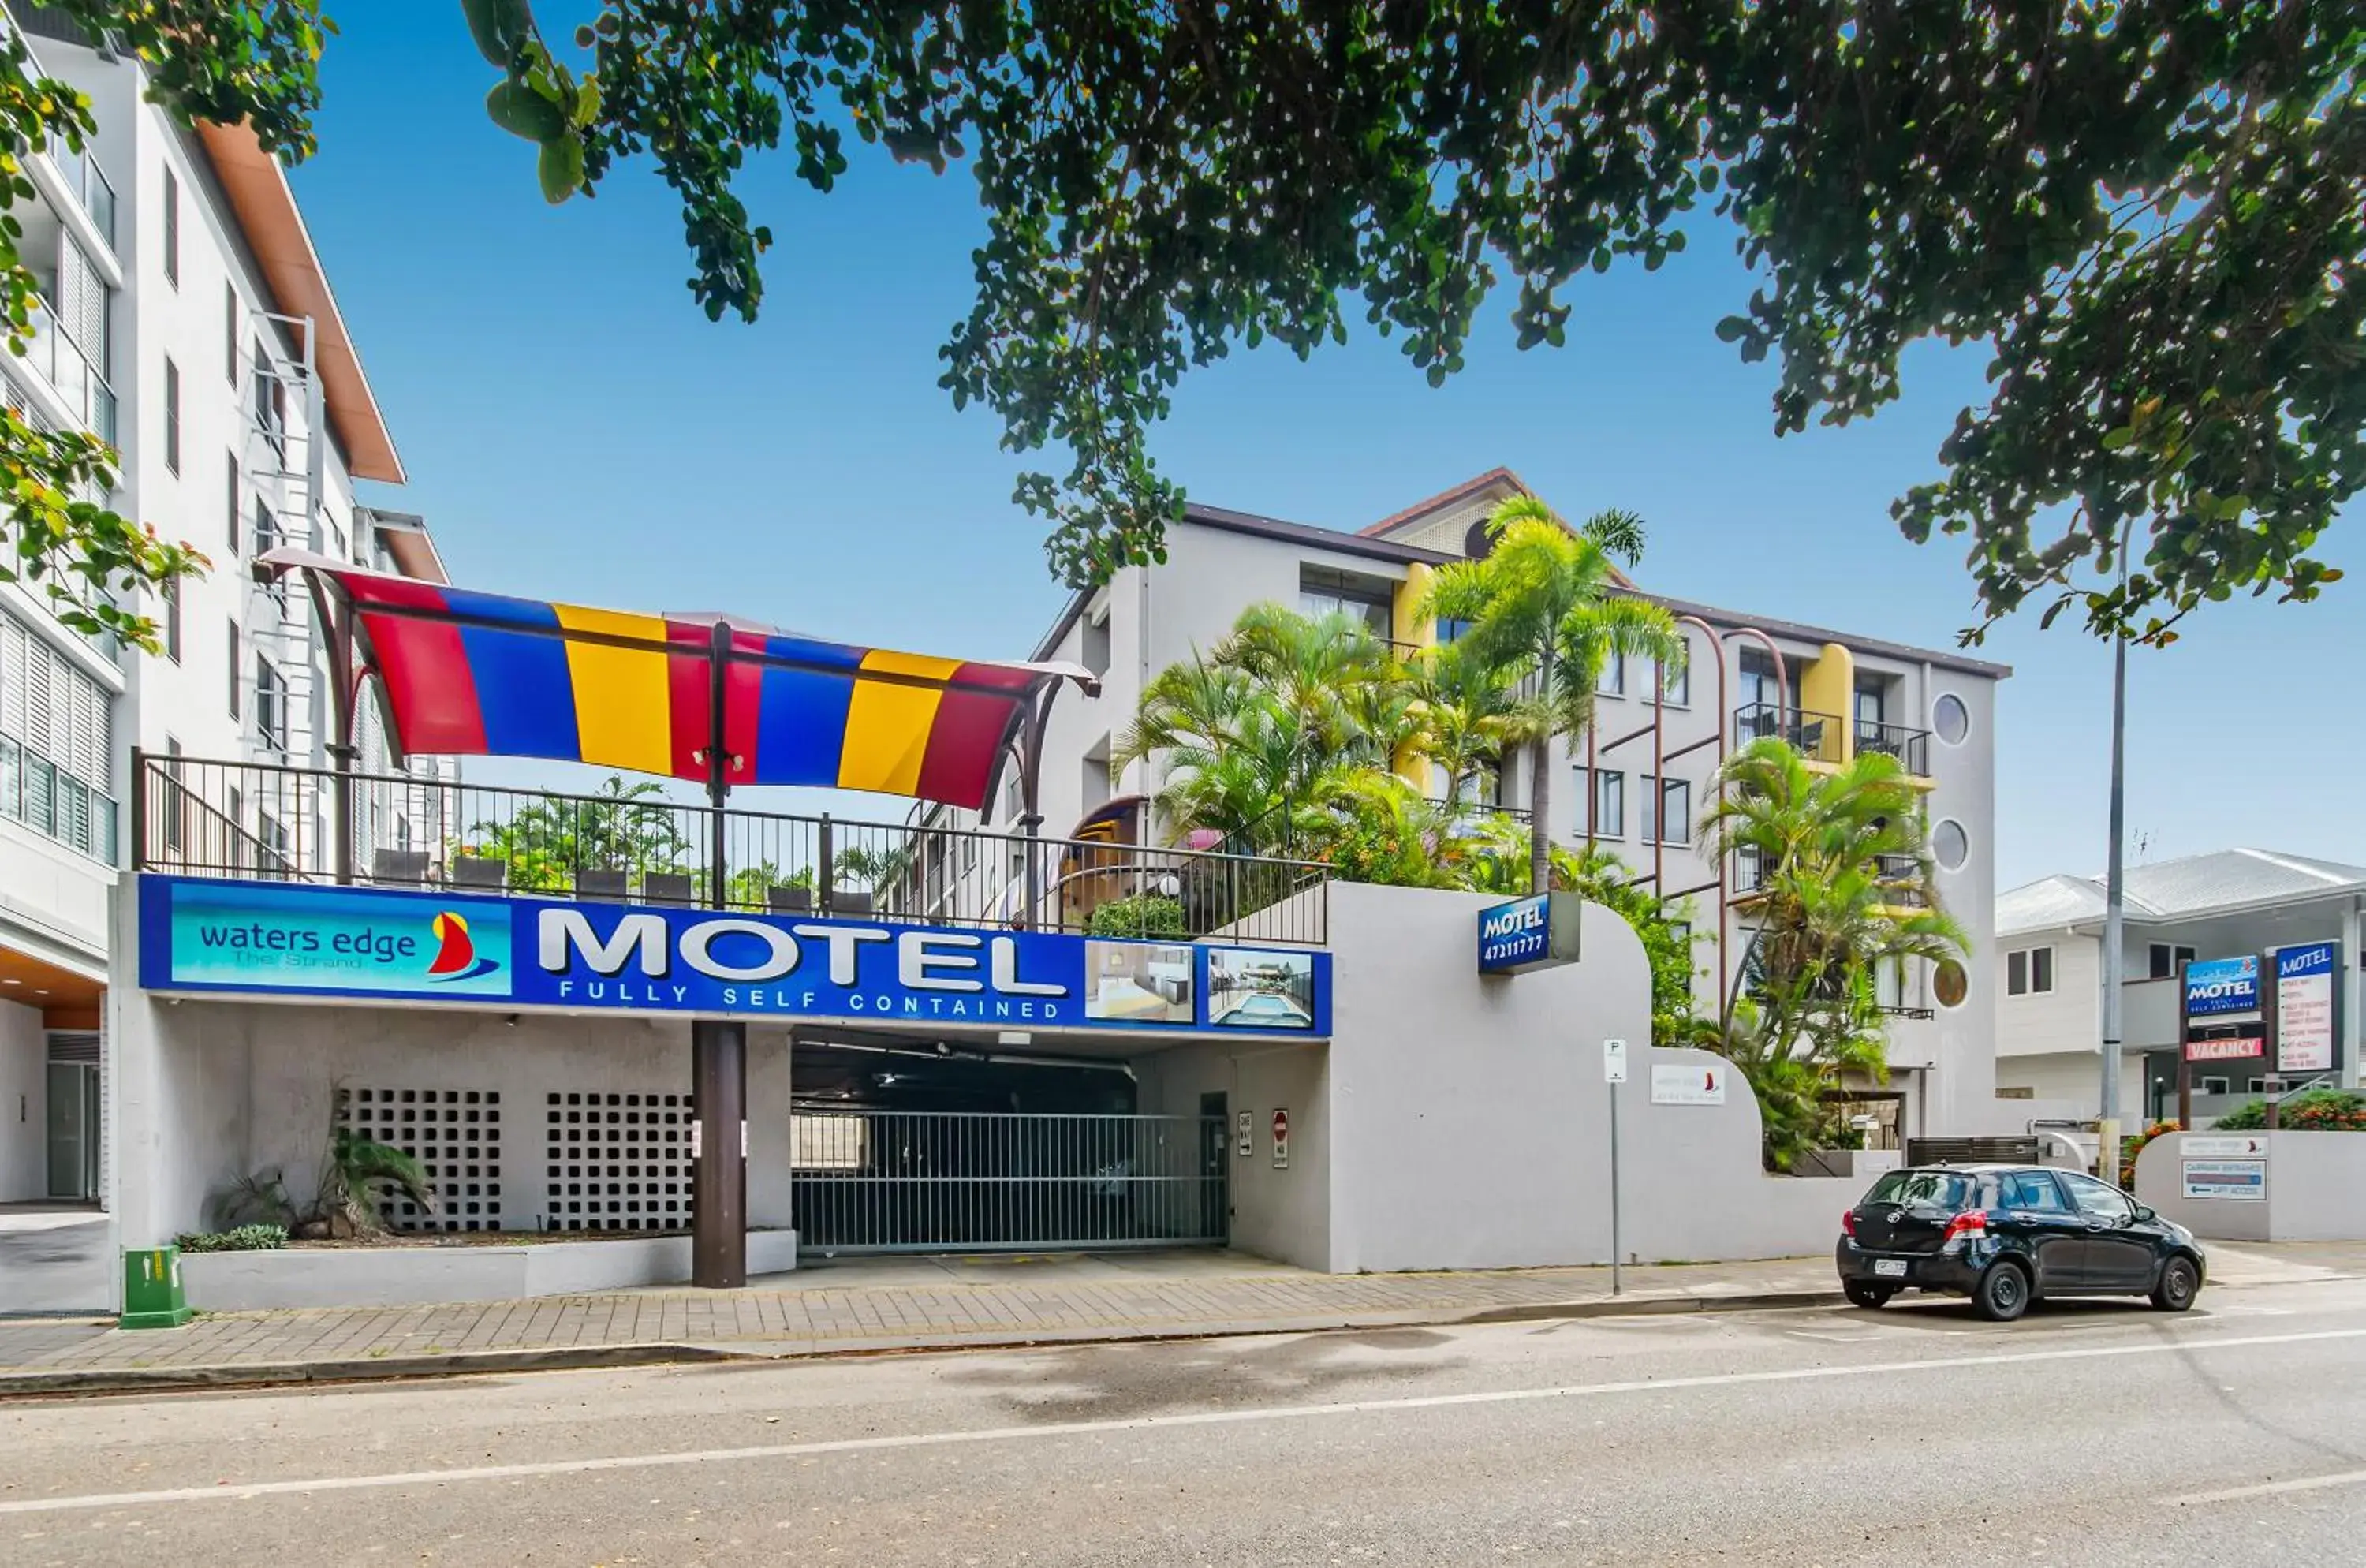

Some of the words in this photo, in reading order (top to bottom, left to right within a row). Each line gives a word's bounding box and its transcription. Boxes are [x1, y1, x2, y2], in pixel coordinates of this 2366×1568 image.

[1483, 905, 1543, 939] MOTEL
[200, 923, 319, 951] waters
[332, 926, 416, 963] edge
[539, 908, 1068, 995] MOTEL
[1484, 935, 1543, 960] 47211777
[231, 950, 274, 965] The
[285, 953, 363, 969] Strand
[2280, 948, 2331, 976] MOTEL
[560, 980, 687, 1002] FULLY
[722, 988, 815, 1008] SELF
[849, 994, 1058, 1019] CONTAINED
[2188, 980, 2255, 1000] MOTEL
[1611, 1042, 1619, 1053] P
[2191, 1040, 2257, 1058] VACANCY
